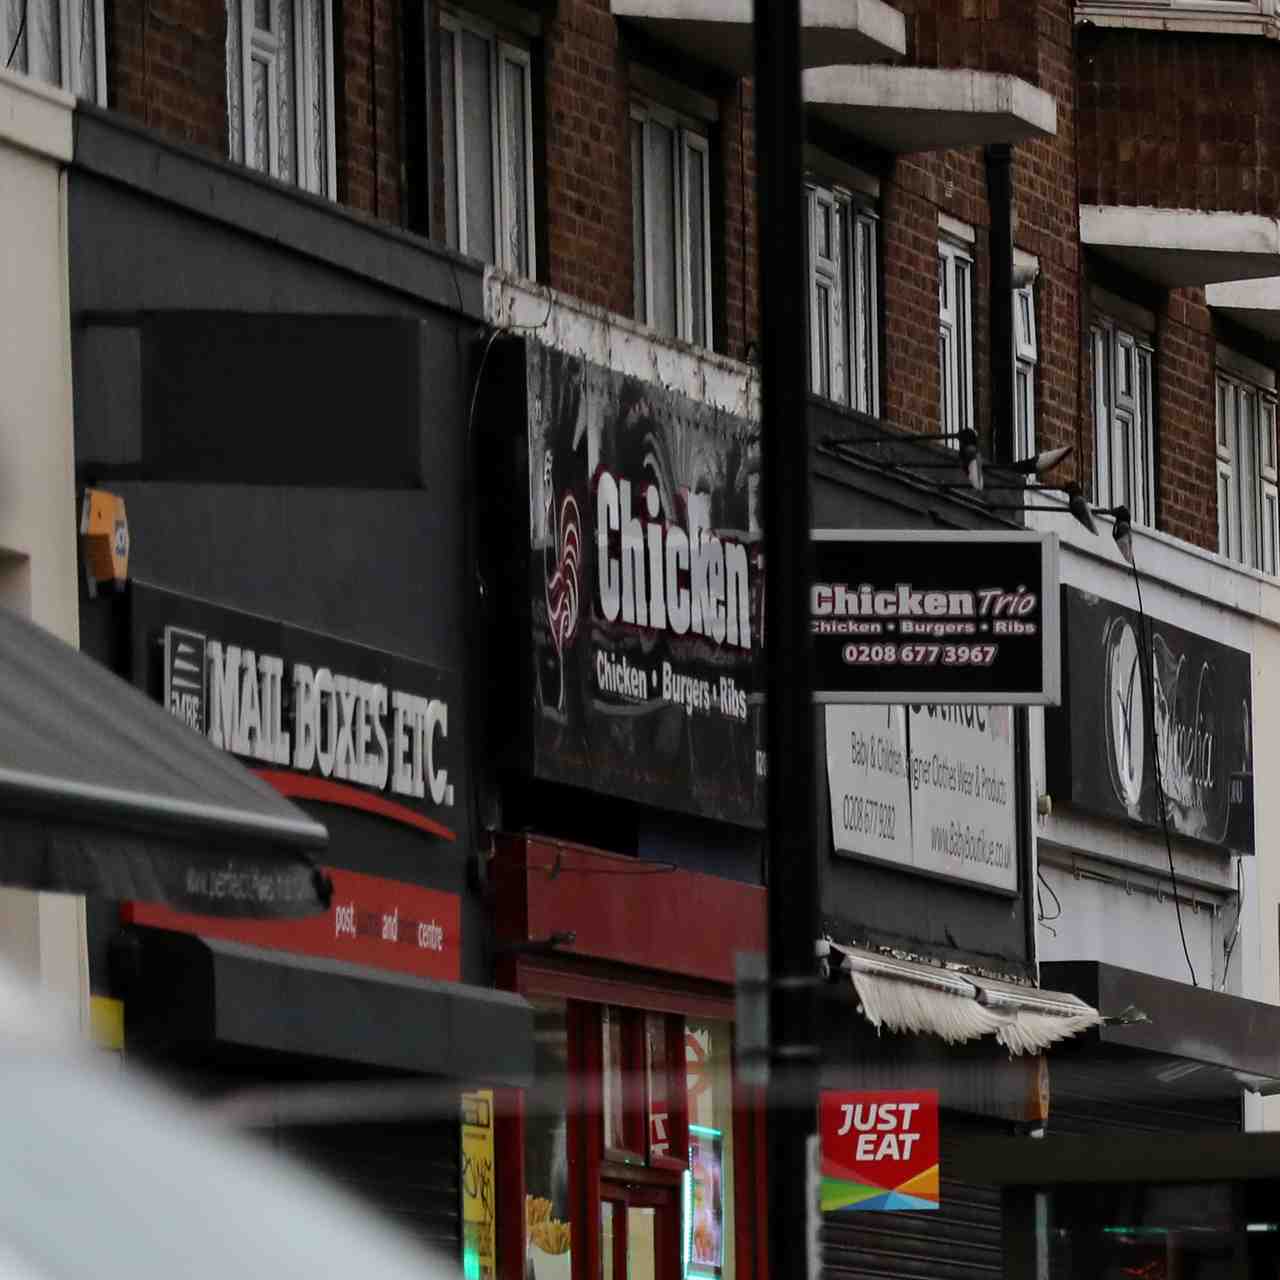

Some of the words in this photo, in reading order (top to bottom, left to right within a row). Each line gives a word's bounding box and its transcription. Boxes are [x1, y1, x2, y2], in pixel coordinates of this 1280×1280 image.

[597, 470, 752, 649] Chicken
[811, 584, 975, 617] Chicken
[977, 585, 1037, 616] Trio
[901, 620, 976, 637] Burgers
[993, 620, 1037, 635] Ribs
[844, 645, 897, 665] 0208
[899, 645, 940, 665] 677
[943, 645, 998, 665] 3967
[595, 649, 648, 700] Chicken
[662, 660, 711, 717] Burgers
[719, 676, 748, 720] Ribs
[206, 640, 291, 766] MAIL
[293, 663, 390, 790] BOXES
[391, 690, 455, 806] ETC.
[382, 907, 398, 943] and
[417, 919, 443, 951] centre
[837, 1103, 921, 1137] JUST
[854, 1133, 921, 1162] EAT
